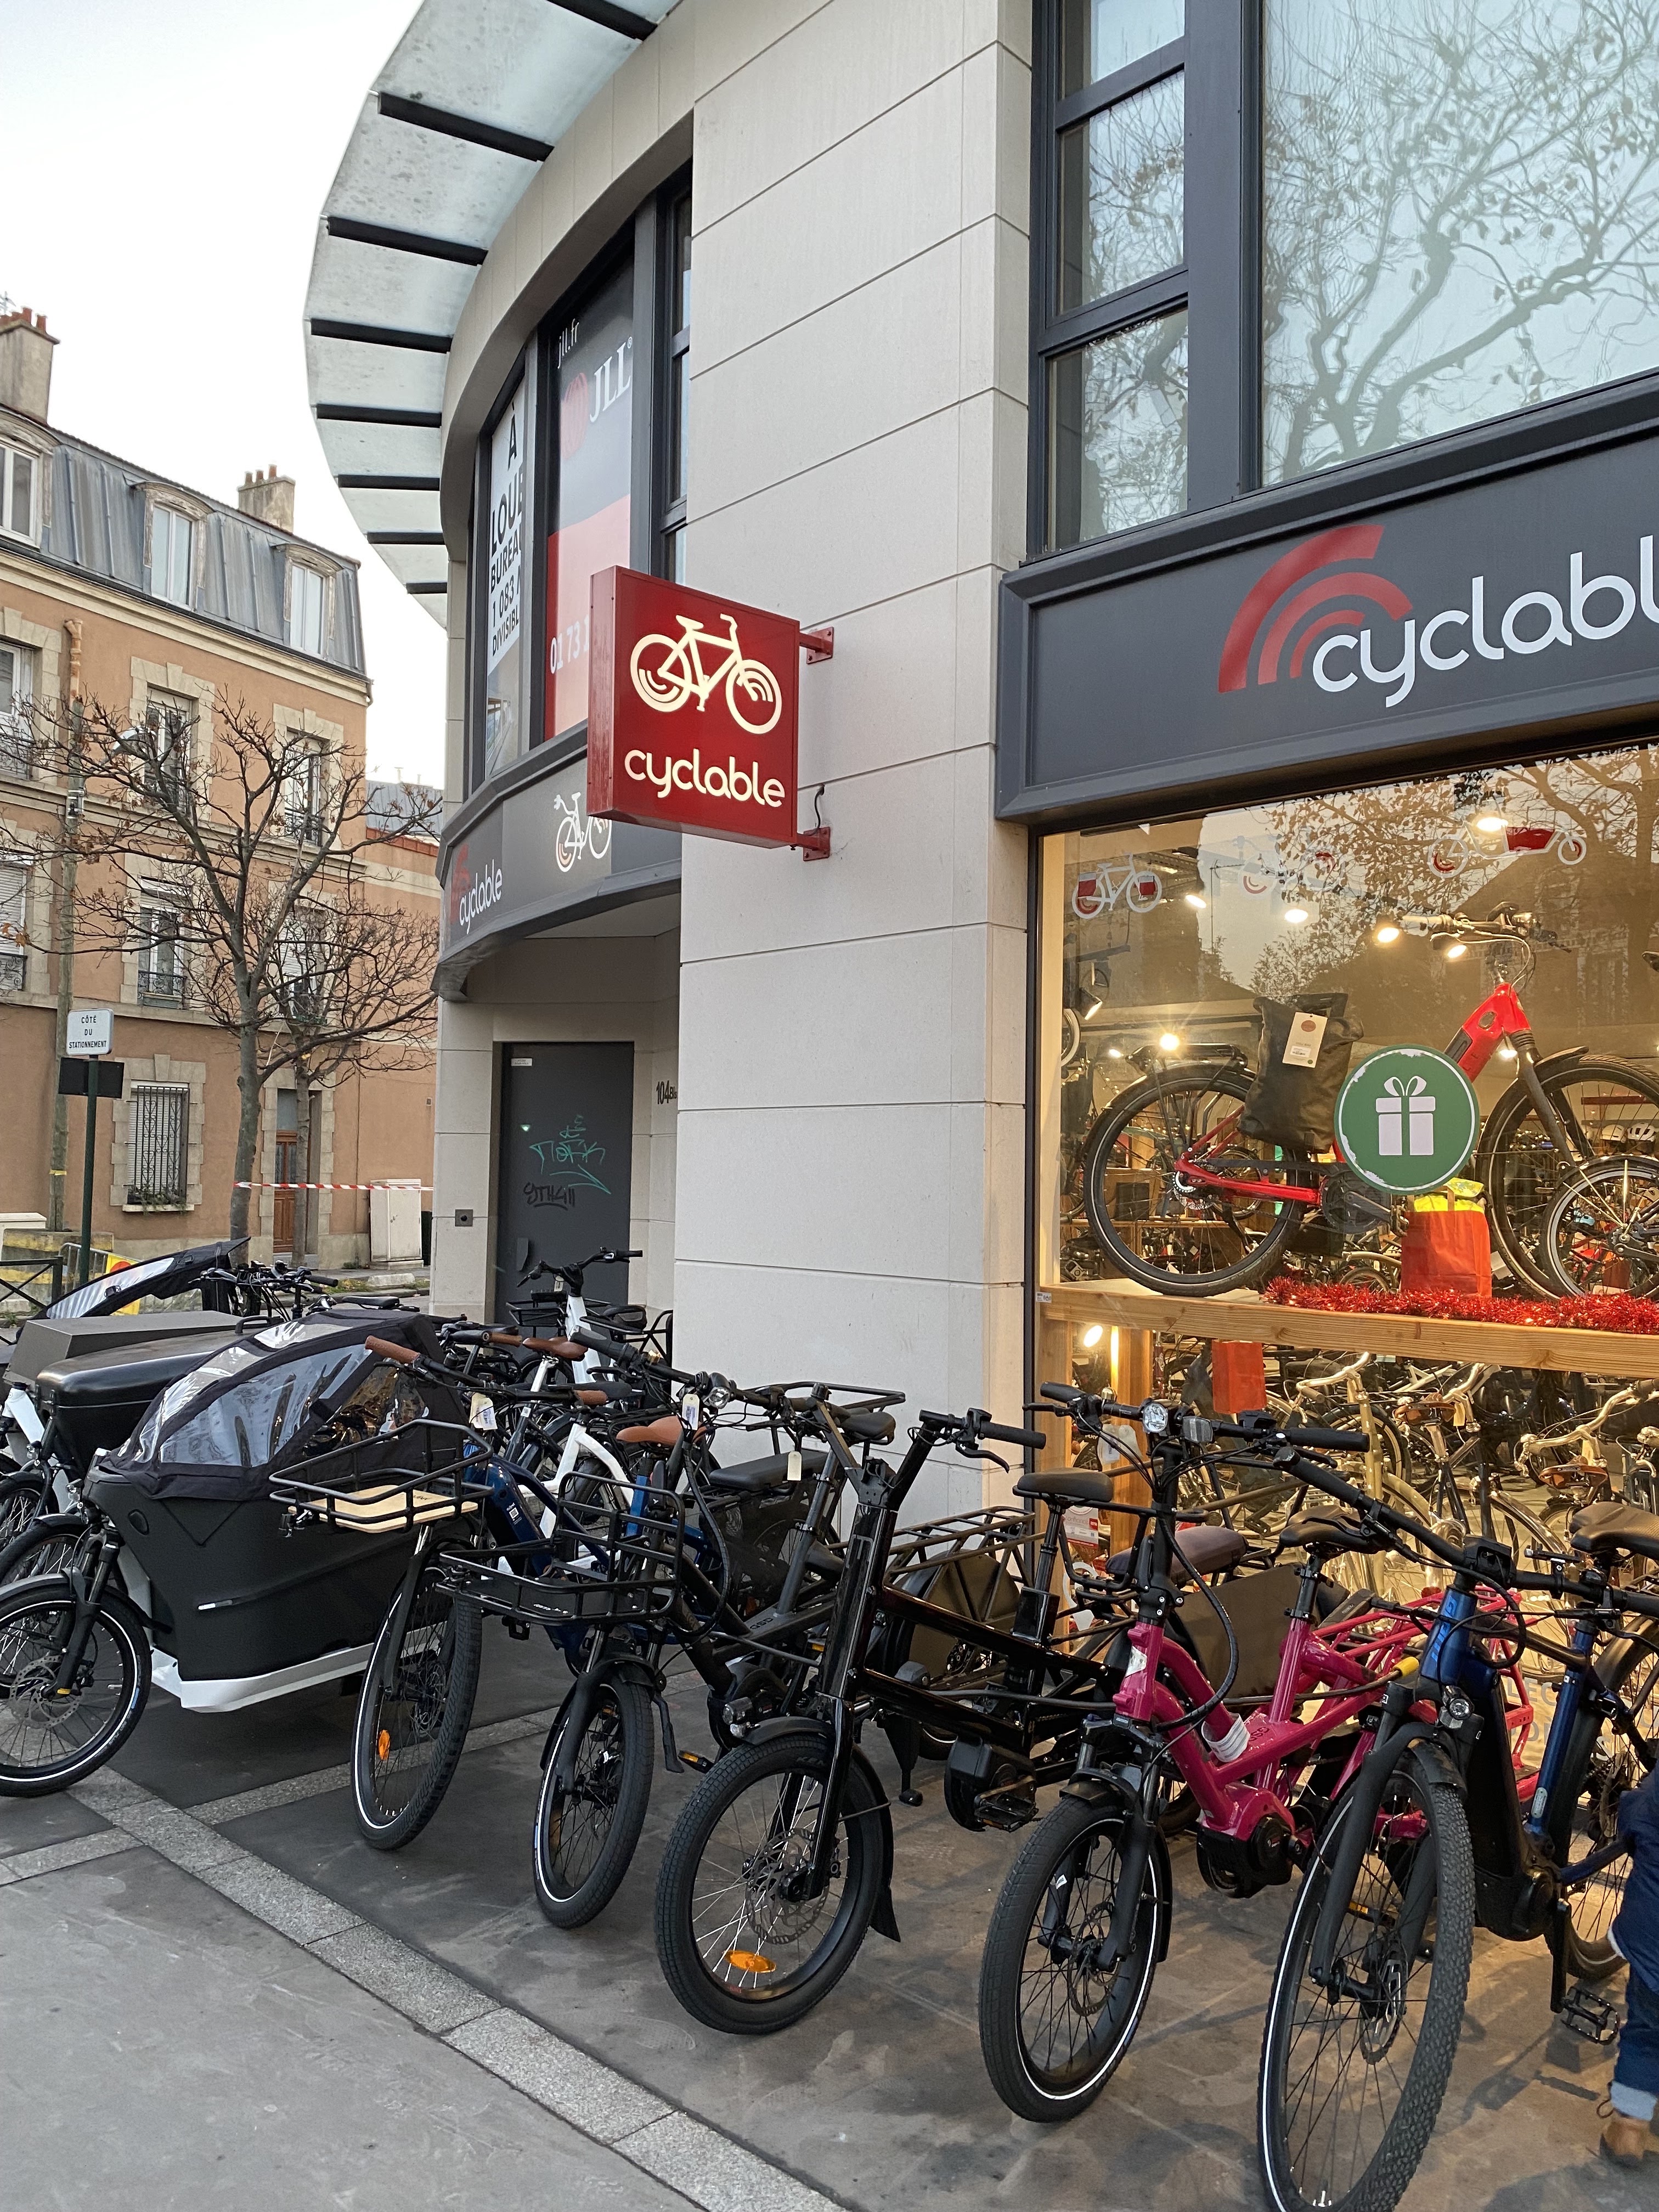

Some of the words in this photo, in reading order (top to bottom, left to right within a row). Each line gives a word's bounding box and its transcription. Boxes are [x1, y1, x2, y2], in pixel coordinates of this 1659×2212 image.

[557, 318, 579, 369] jll.fr
[492, 466, 523, 558] LOUE
[499, 575, 514, 618] 083
[493, 605, 518, 657] DIVISIBL
[624, 748, 785, 808] cyclable
[459, 859, 503, 935] cyclable
[69, 1040, 106, 1048] STATIONNEMENT
[81, 1015, 97, 1024] CÔTÉ
